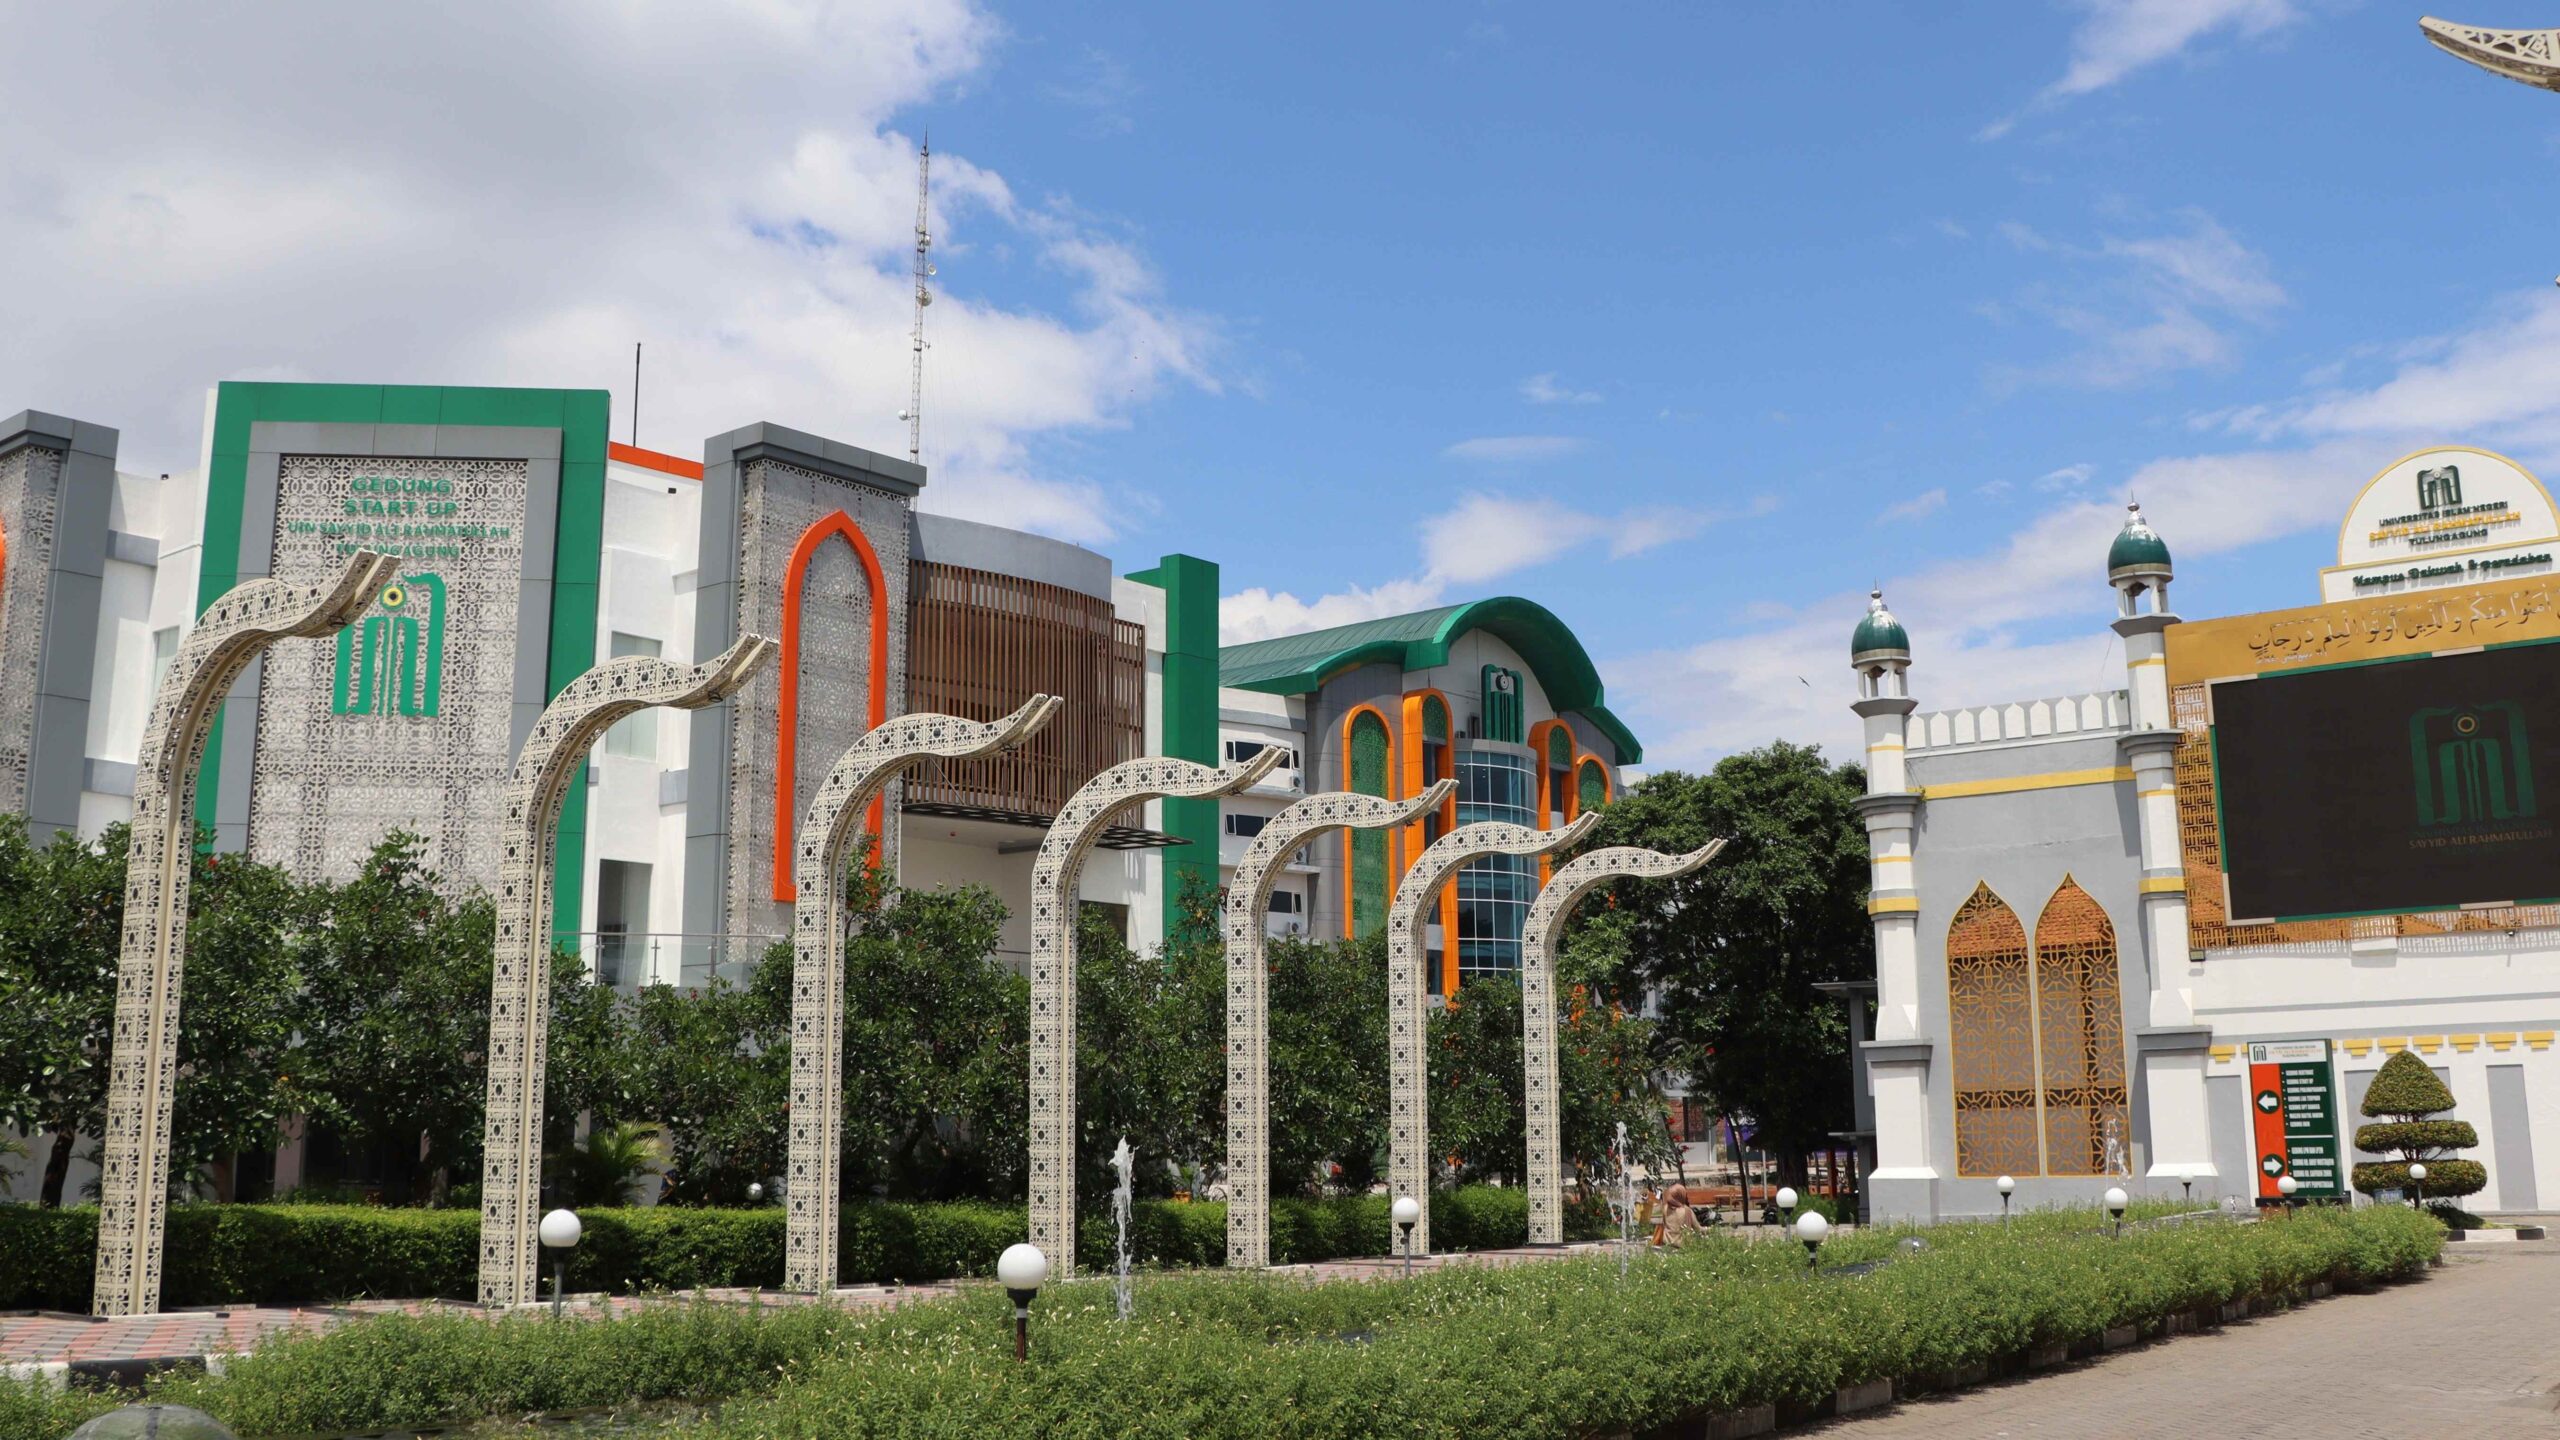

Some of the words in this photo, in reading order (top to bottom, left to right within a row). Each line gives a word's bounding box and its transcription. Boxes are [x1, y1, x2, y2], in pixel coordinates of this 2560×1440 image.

[352, 477, 452, 494] GEDUNG
[344, 498, 416, 515] START
[427, 501, 458, 516] UP
[2378, 509, 2440, 527] UNIVERSITAS
[2441, 505, 2471, 518] ISLAM
[2472, 500, 2509, 514] NEGERI
[287, 520, 317, 533] UIN
[319, 521, 372, 536] SAYYID
[374, 523, 400, 537] ALI
[2407, 528, 2489, 546] TULUNGAGUNG
[2352, 572, 2405, 587] Kampus
[2408, 562, 2464, 579] Dakwah
[2467, 559, 2478, 570] &
